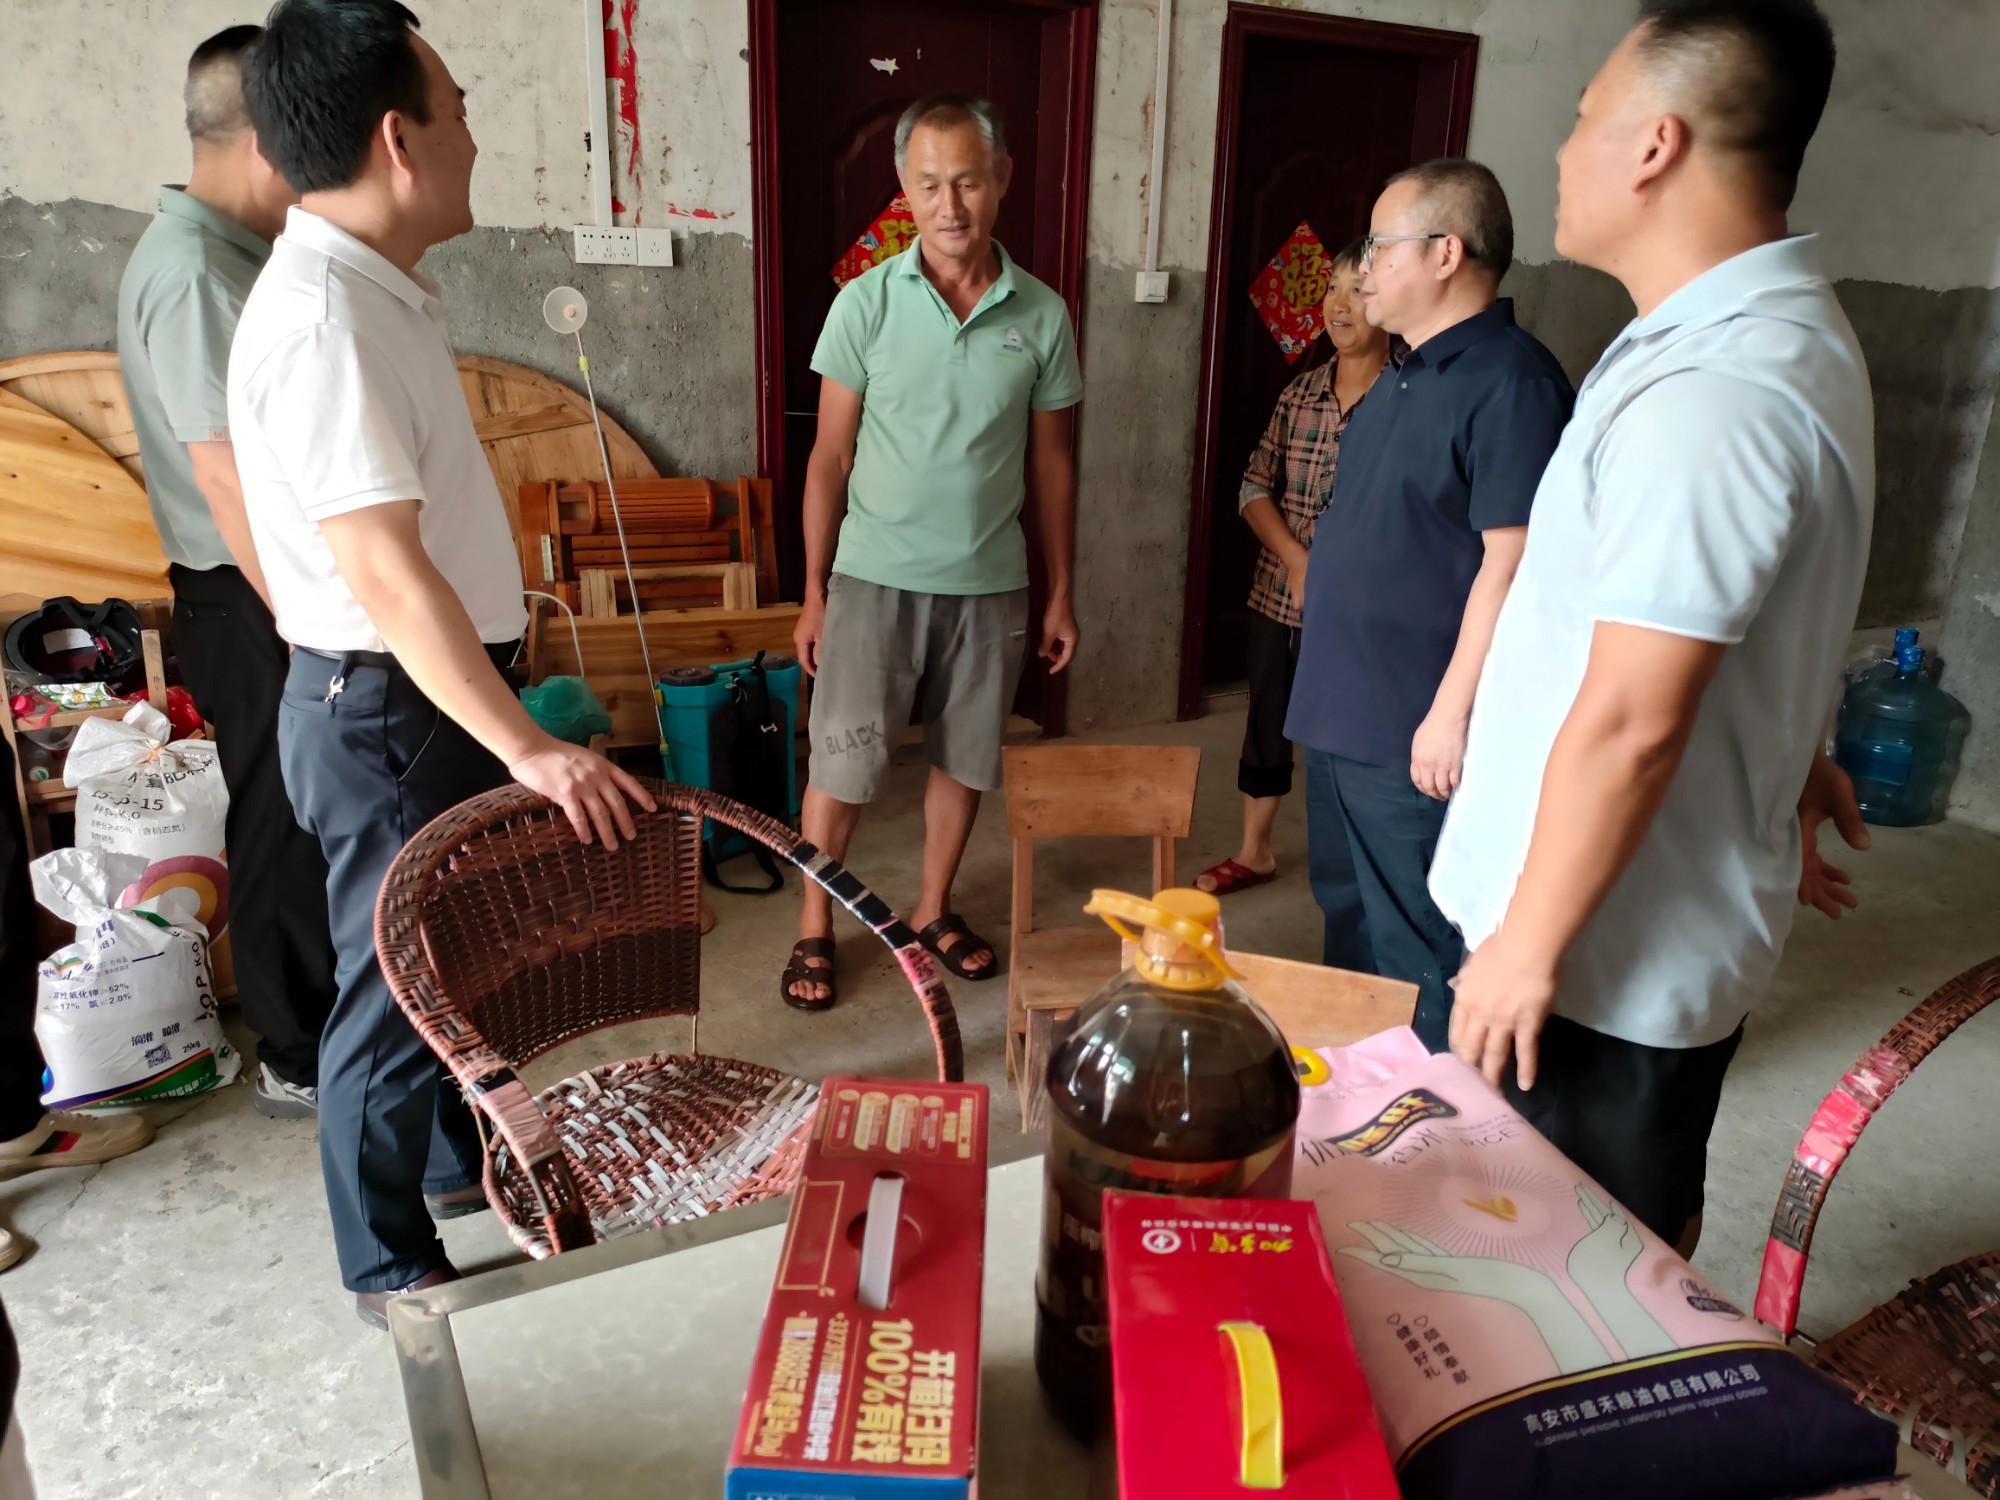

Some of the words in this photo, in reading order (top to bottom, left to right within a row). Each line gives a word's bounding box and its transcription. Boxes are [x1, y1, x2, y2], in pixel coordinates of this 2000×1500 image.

[1281, 243, 1327, 306] 福
[825, 720, 884, 759] BLACK
[182, 1040, 201, 1053] 25kg
[851, 1319, 914, 1463] 100%有钱
[902, 1351, 955, 1465] 开箱扫码
[1523, 1363, 1761, 1434] 高安市盛禾粮油食品有限公司
